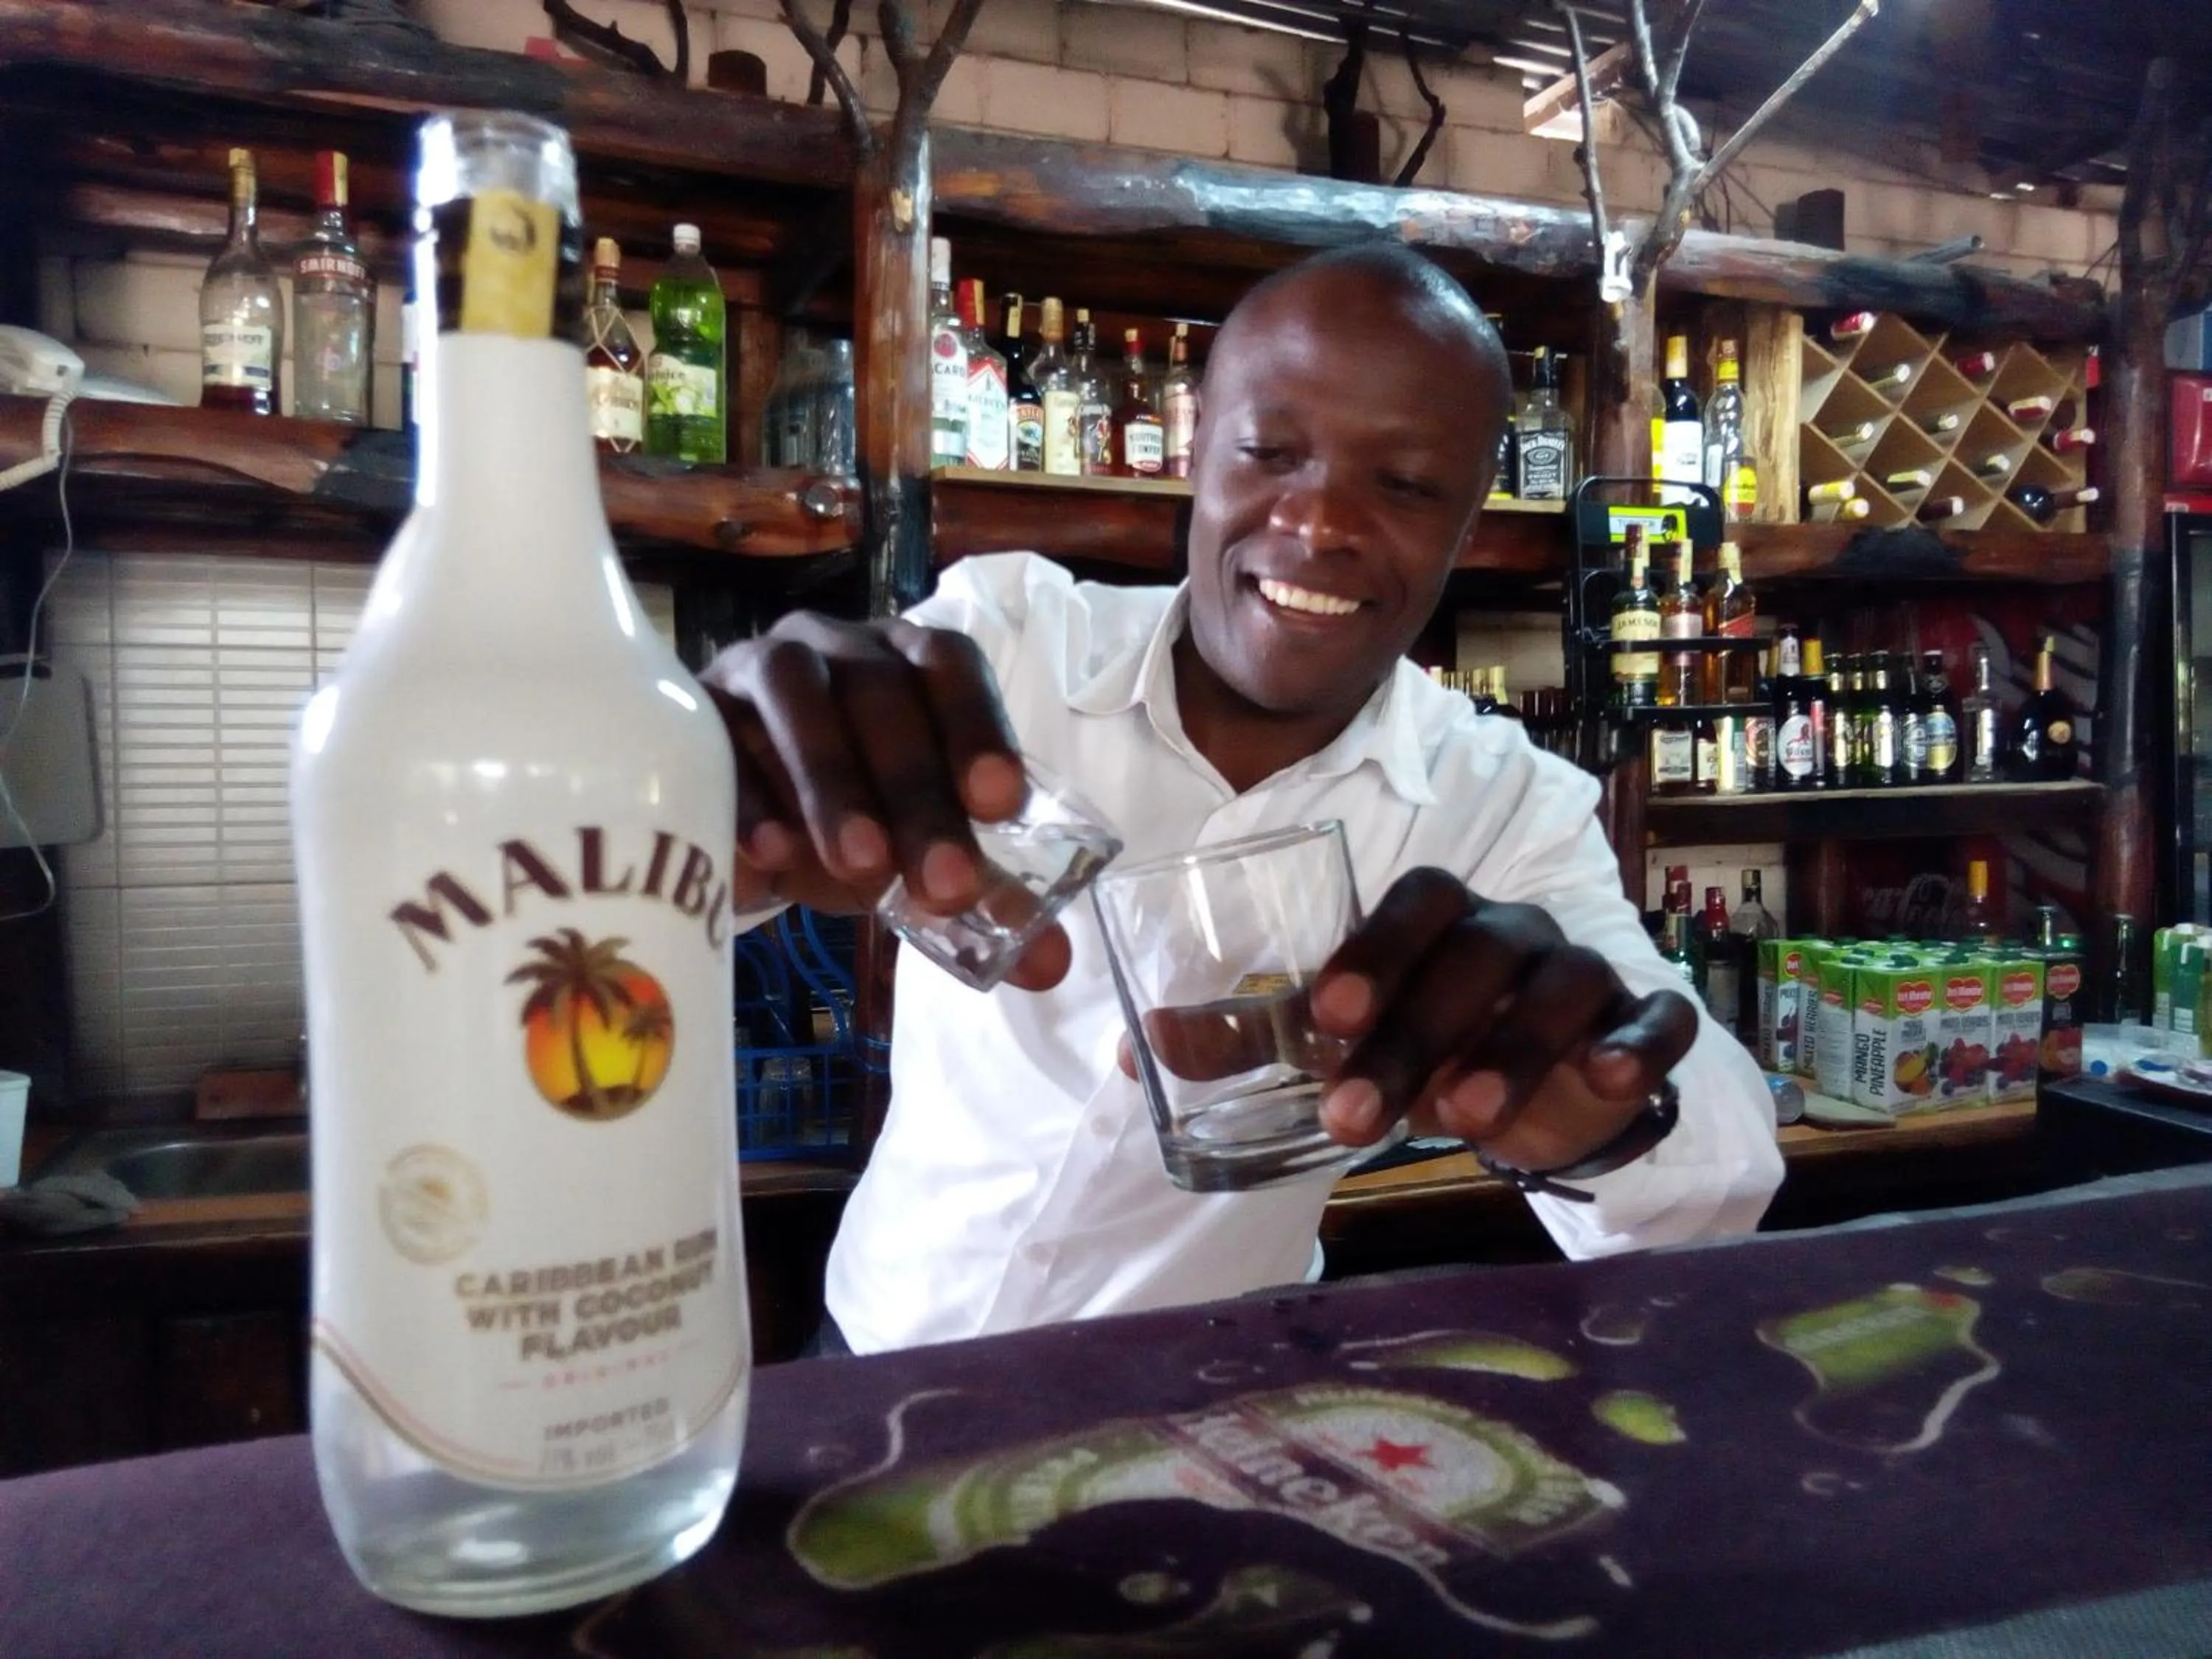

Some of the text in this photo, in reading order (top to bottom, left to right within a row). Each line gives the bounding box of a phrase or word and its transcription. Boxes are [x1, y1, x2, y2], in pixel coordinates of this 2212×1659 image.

[1854, 1033, 1871, 1084] MANGO
[1869, 1027, 1888, 1096] PINEAPPLE
[455, 1245, 666, 1298] CARIBBEAN
[466, 1298, 562, 1330] WITH
